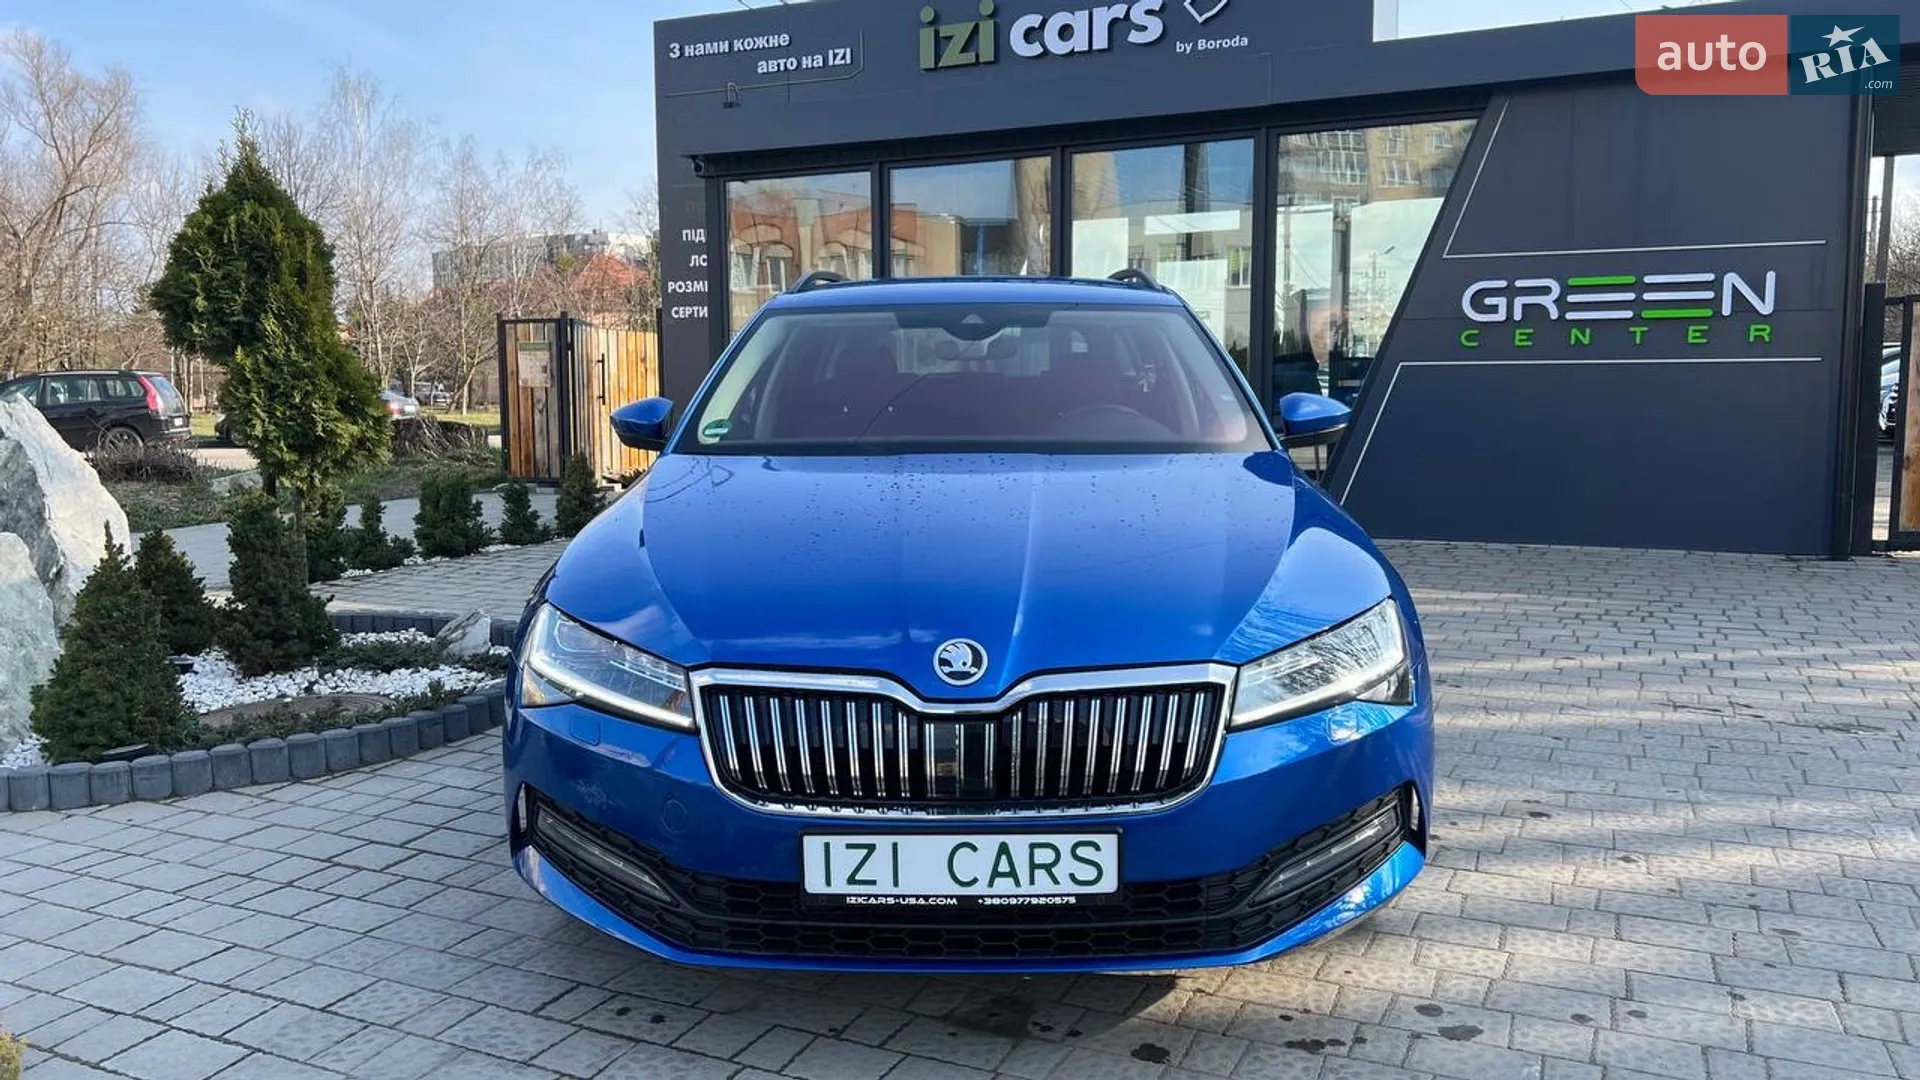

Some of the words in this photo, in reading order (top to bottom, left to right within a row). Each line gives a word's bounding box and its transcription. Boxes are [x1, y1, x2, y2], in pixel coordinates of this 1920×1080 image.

[684, 40, 729, 57] нами
[733, 33, 790, 51] кожне
[920, 0, 995, 70] izi
[1009, 0, 1164, 57] cars
[1176, 41, 1193, 54] by
[1198, 35, 1249, 50] Boroda
[757, 56, 798, 74] авто
[802, 54, 824, 69] на
[828, 48, 852, 66] IZI
[1462, 270, 1776, 322] GREEN
[671, 306, 708, 319] СЕРТИ
[1460, 325, 1772, 347] CENTER
[823, 841, 899, 888] IZI
[947, 840, 1104, 888] CARS
[846, 896, 958, 905] IZICARS-USA.COM
